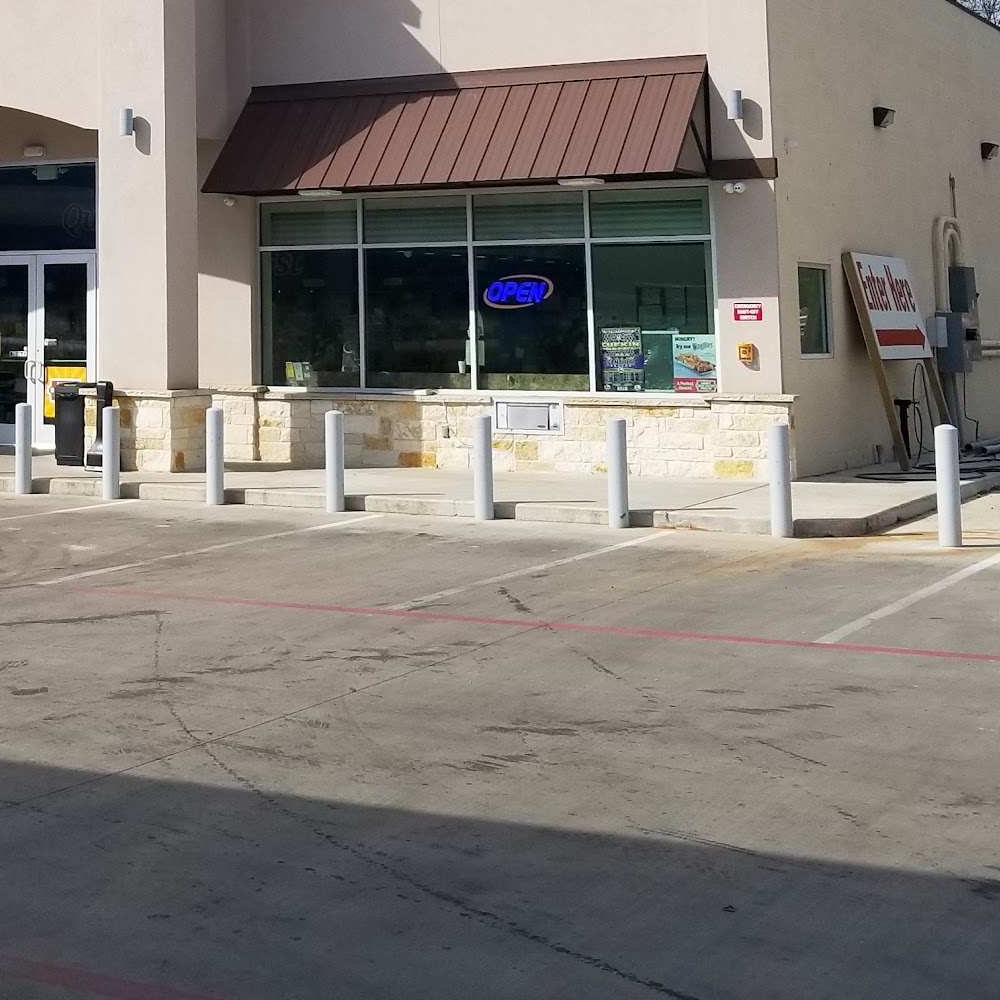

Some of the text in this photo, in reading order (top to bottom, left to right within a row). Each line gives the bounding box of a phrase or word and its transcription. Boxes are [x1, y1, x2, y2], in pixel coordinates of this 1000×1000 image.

[487, 281, 547, 303] OPEN
[855, 261, 916, 313] Enter Here
